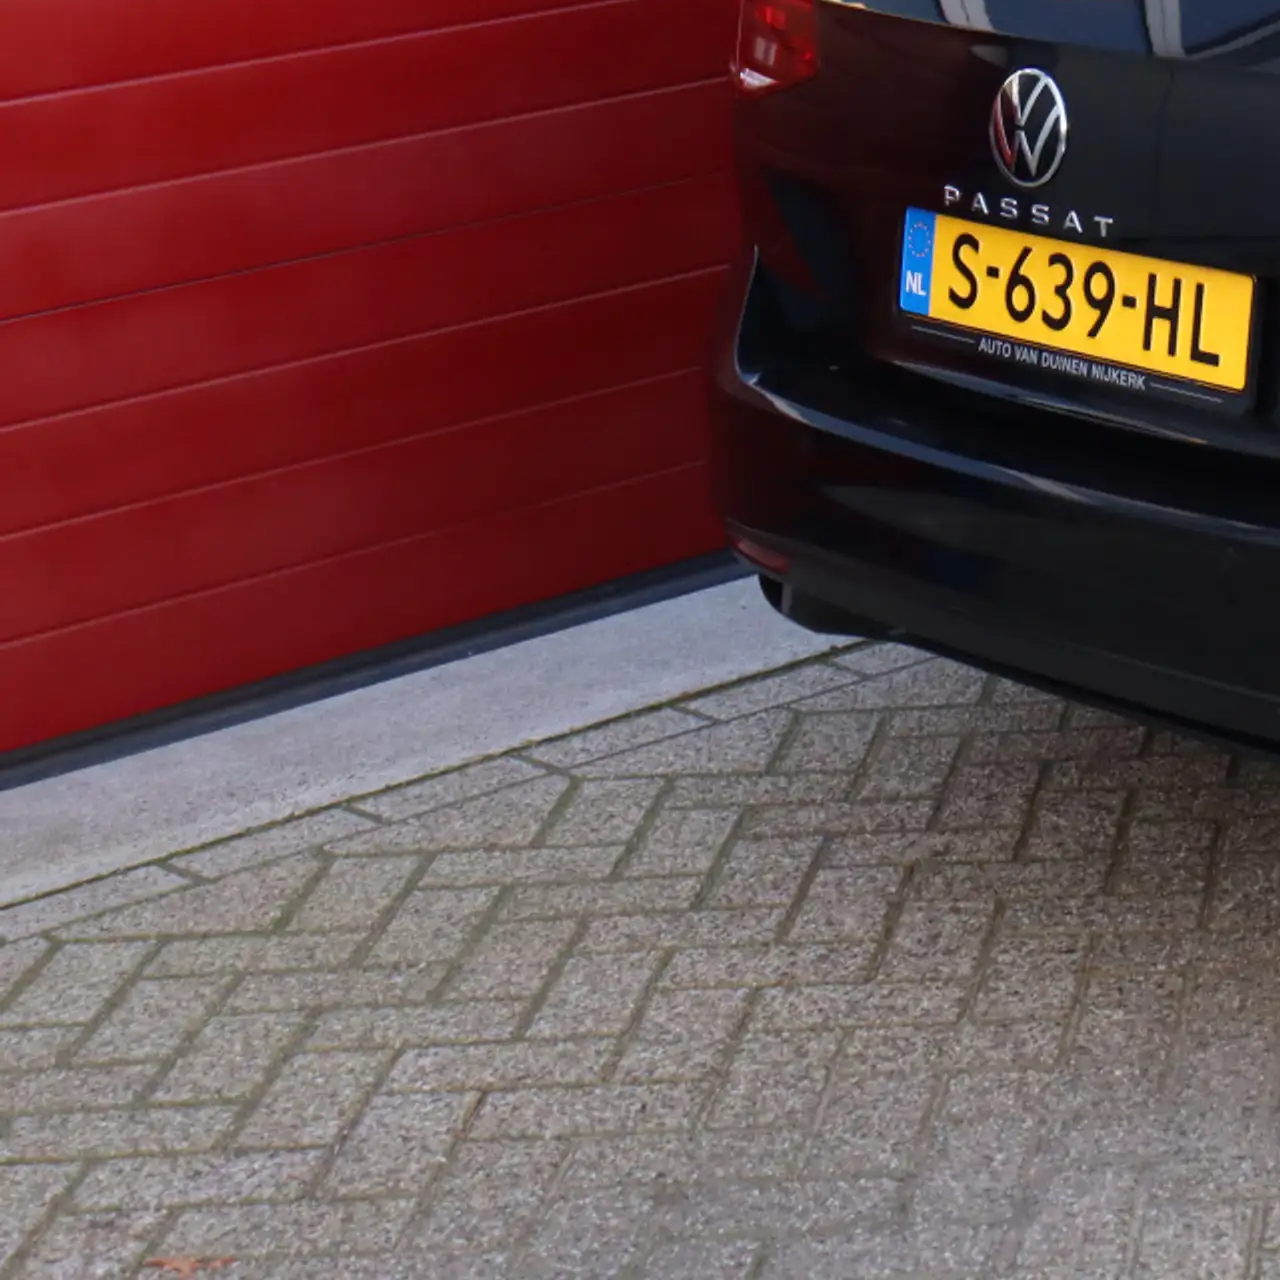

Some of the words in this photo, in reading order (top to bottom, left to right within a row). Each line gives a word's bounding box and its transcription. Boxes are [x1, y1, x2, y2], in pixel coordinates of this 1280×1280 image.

[943, 184, 1114, 237] PASSAT
[905, 269, 927, 296] NL
[948, 232, 1220, 367] S-639-HL
[978, 338, 1012, 358] AUTO
[1013, 346, 1038, 364] VAN
[1041, 352, 1088, 377] DUINEN
[1091, 363, 1146, 390] NIJKERK
